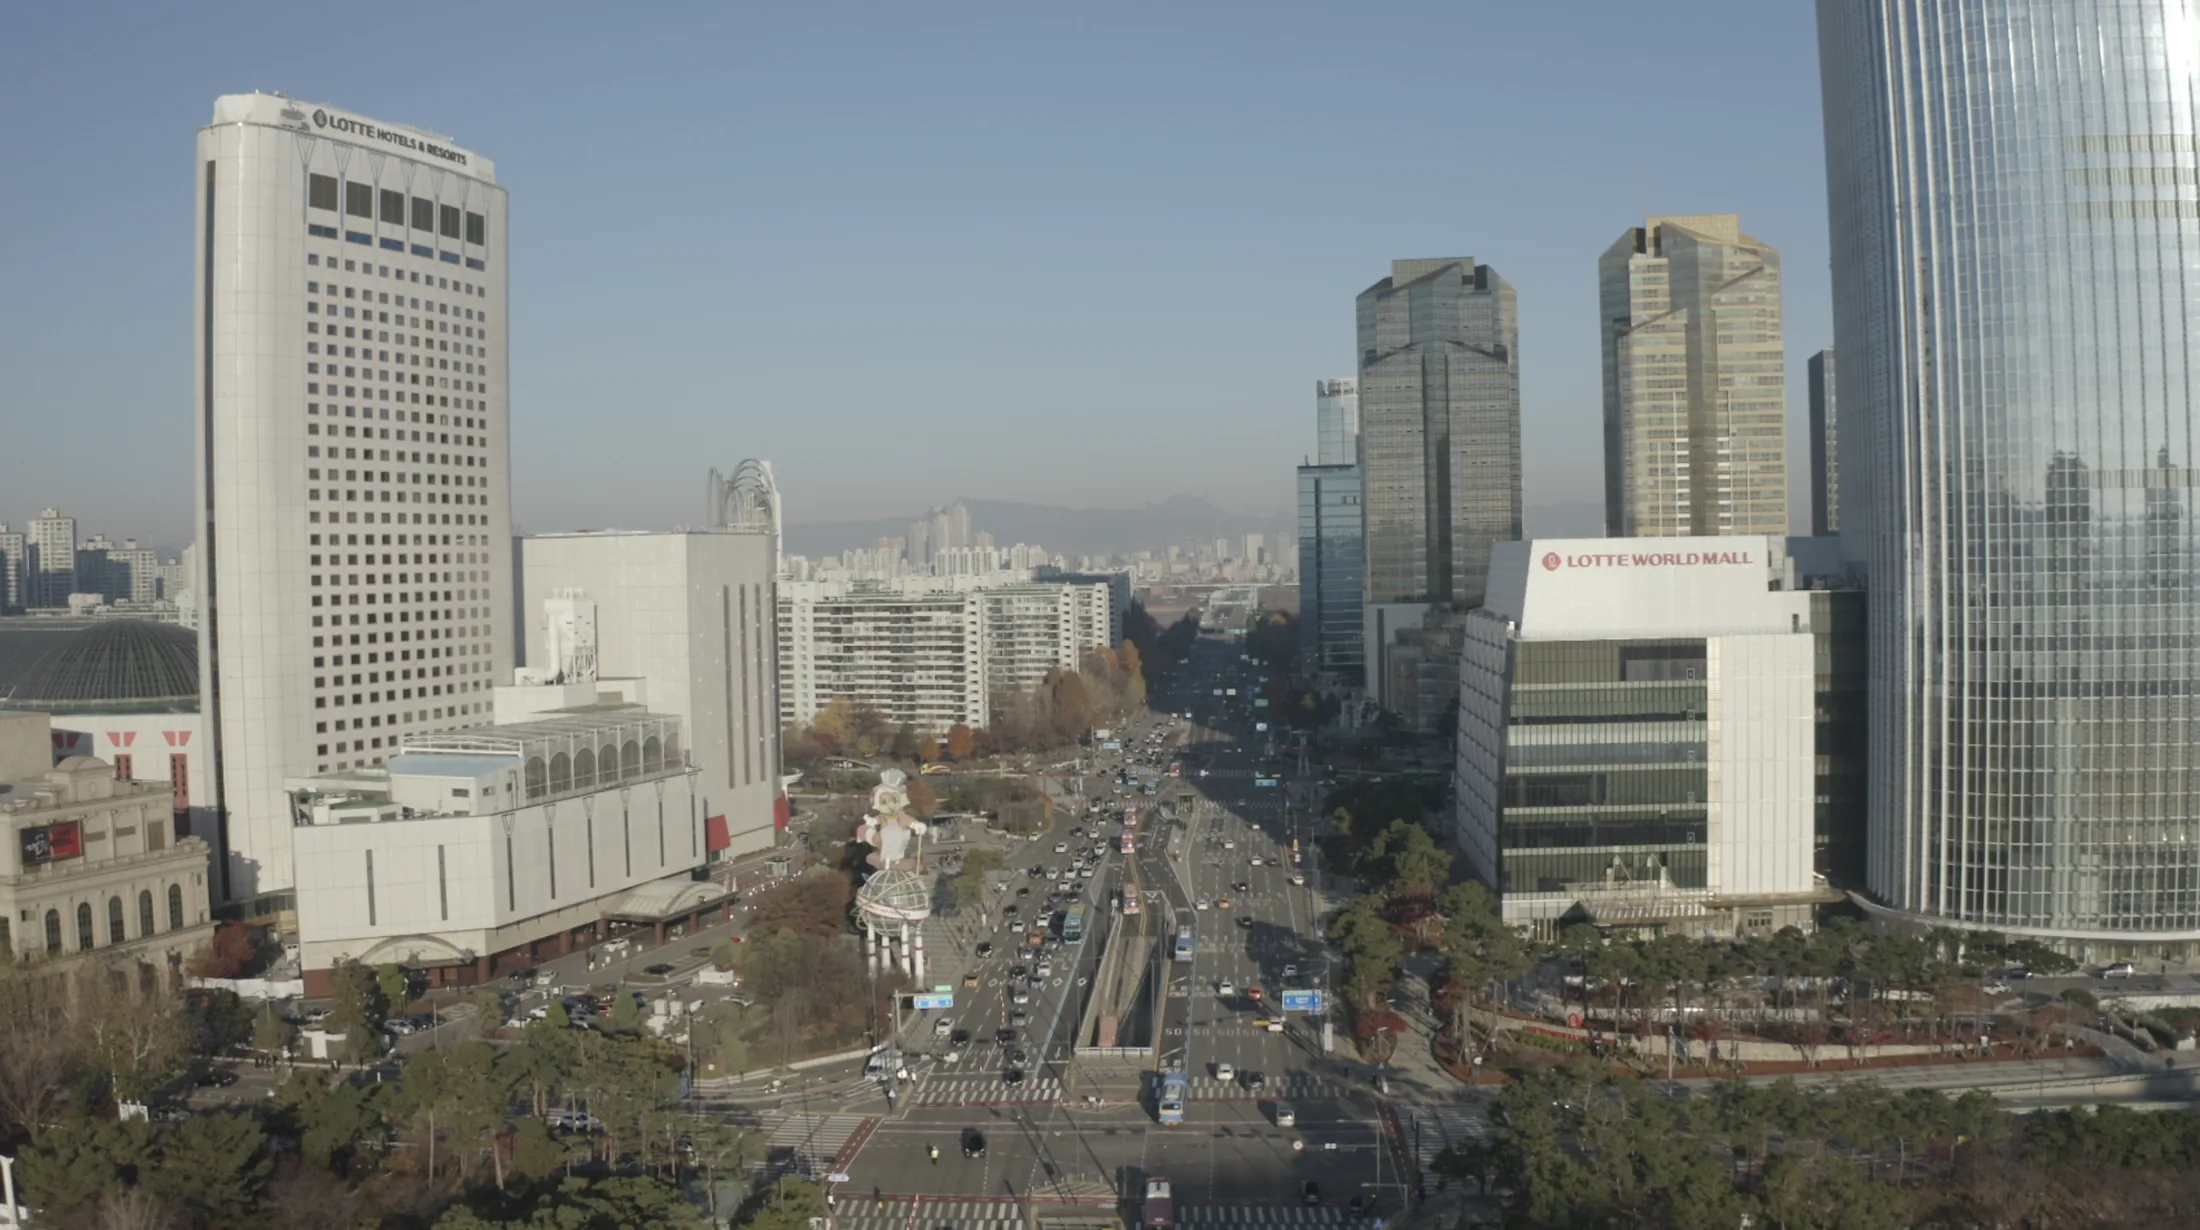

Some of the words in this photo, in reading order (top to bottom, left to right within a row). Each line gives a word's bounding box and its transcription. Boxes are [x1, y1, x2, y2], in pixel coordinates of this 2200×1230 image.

[329, 114, 375, 139] LOTTE
[377, 127, 416, 150] HOTELS
[427, 142, 467, 166] RESORTS
[1566, 554, 1629, 568] LOTTE
[1632, 552, 1700, 567] WORLD
[1702, 551, 1754, 566] MALL
